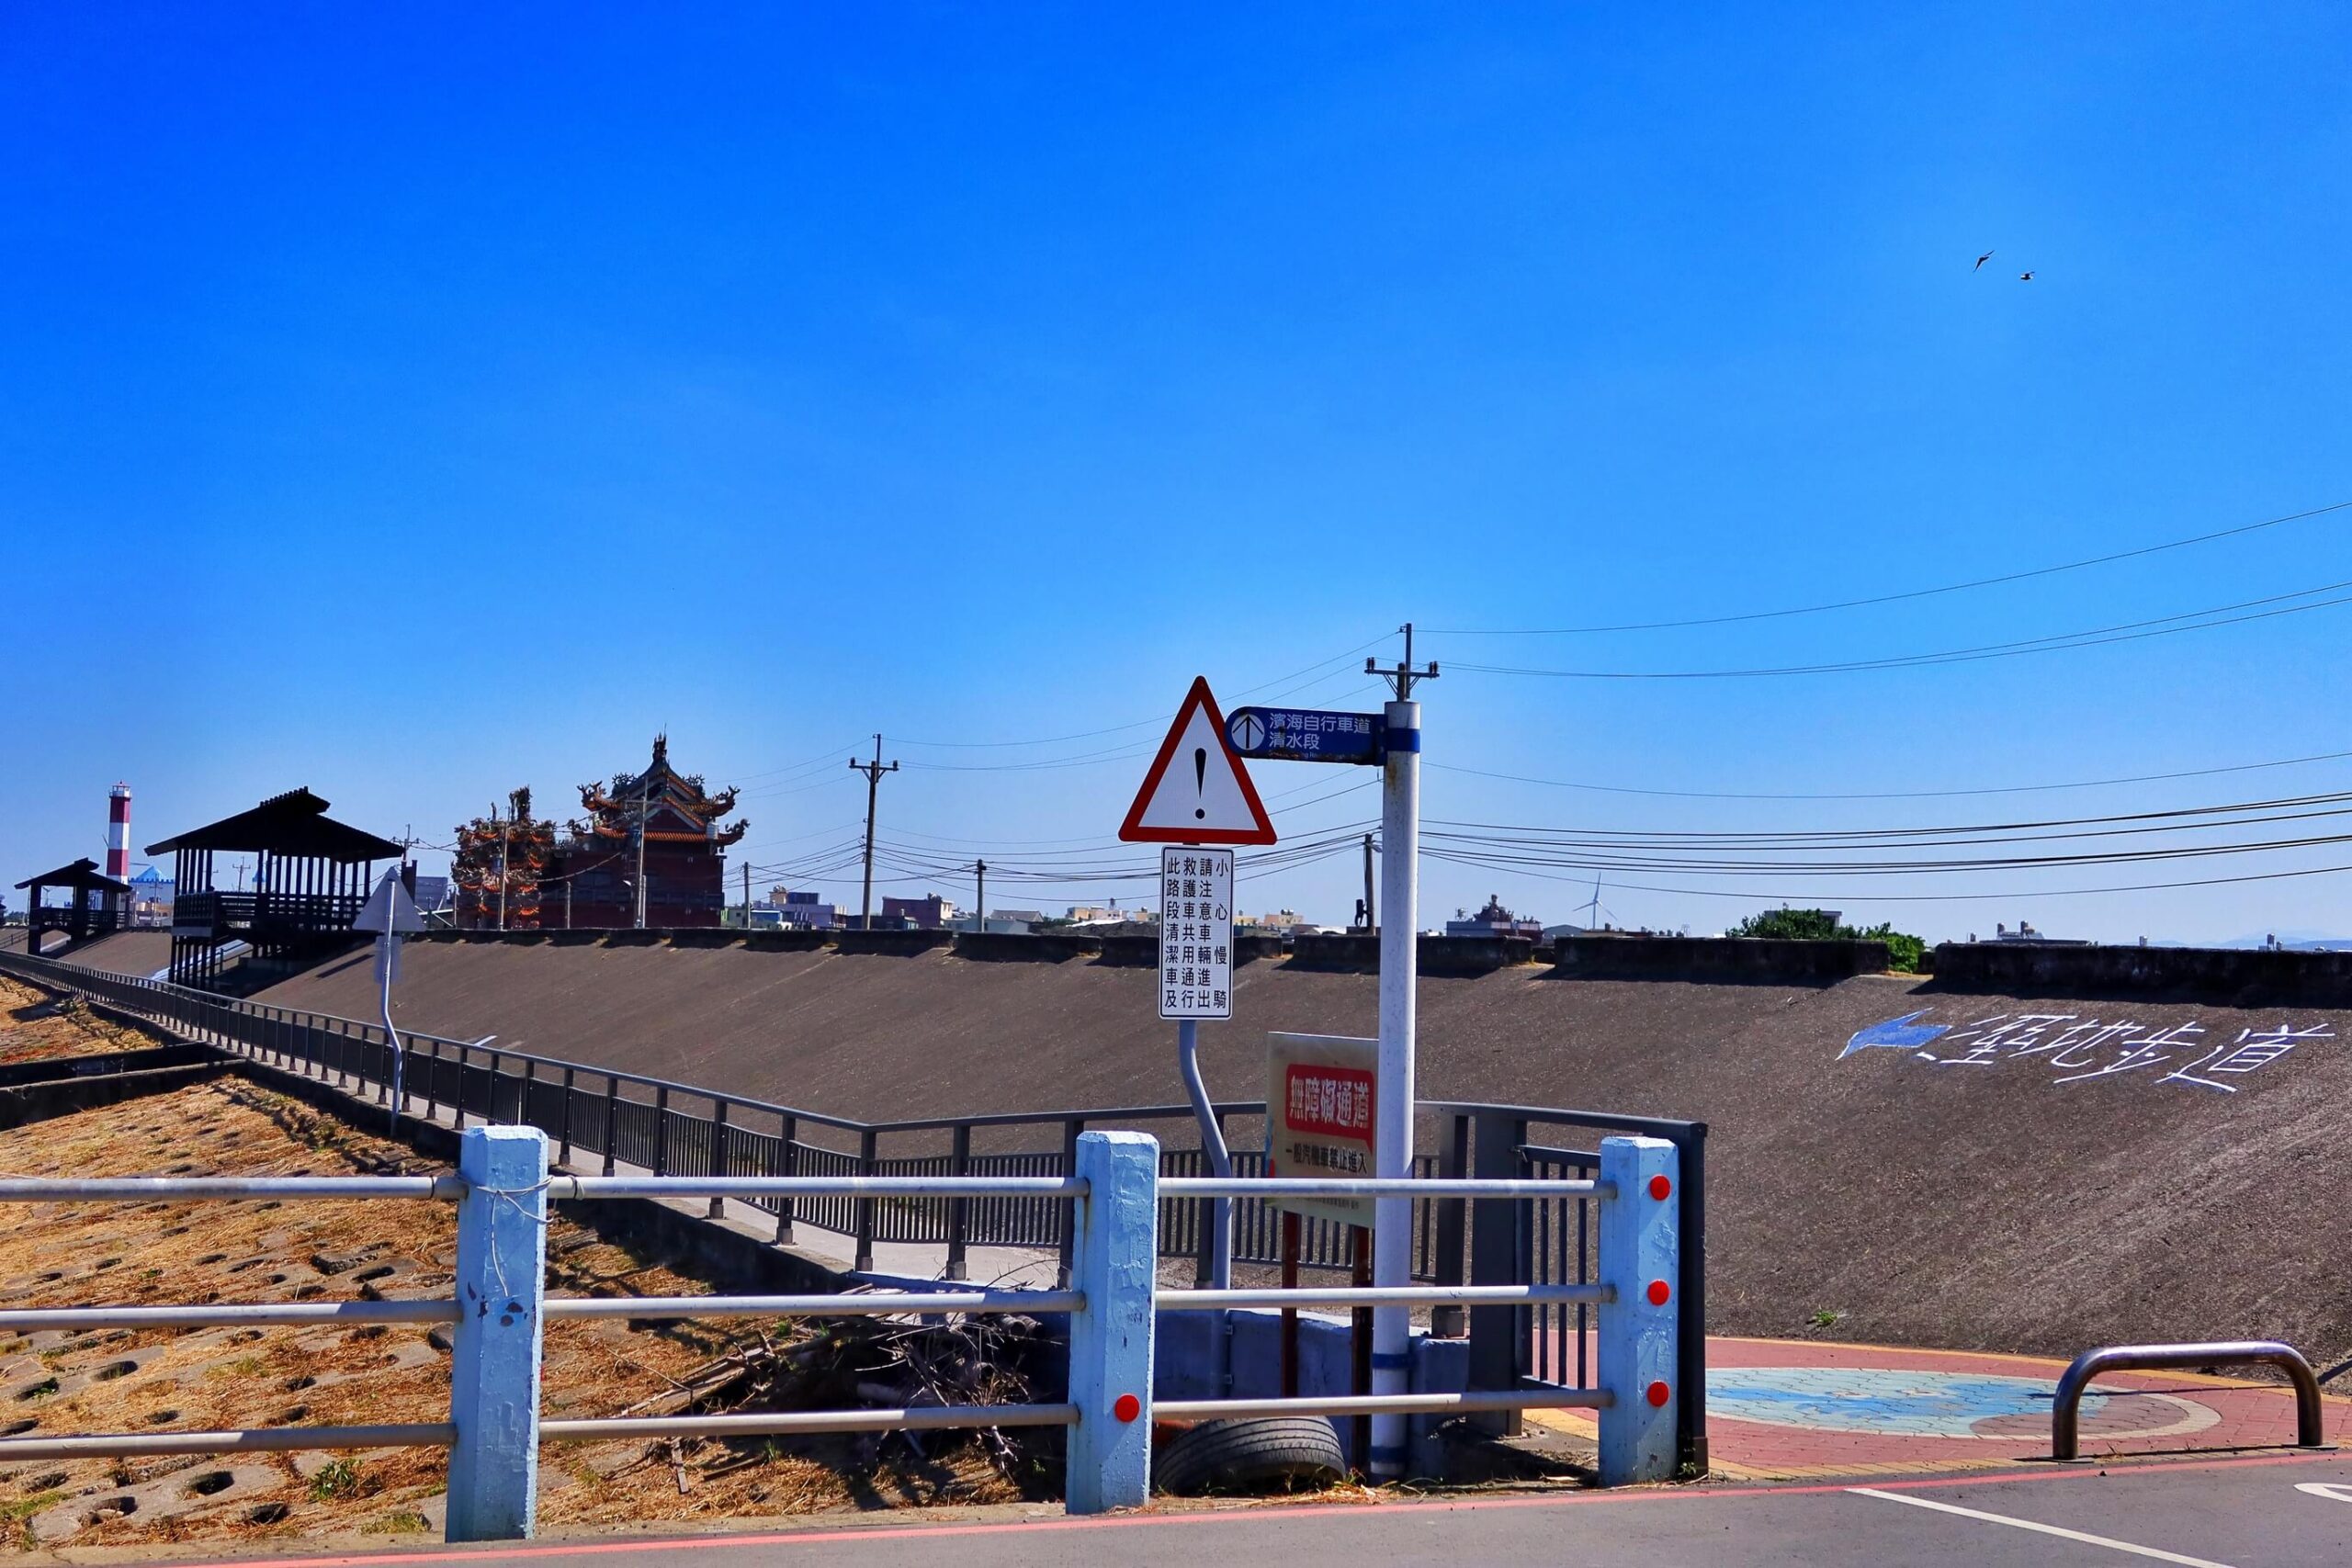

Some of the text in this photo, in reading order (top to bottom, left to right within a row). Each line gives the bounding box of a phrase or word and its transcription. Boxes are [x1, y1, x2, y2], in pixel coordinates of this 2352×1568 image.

[1270, 713, 1371, 734] 濱海自行車道
[1270, 732, 1319, 750] 清水段
[1164, 857, 1181, 1008] 此路段清潔車及
[1182, 858, 1196, 1009] 救護車共用通行
[1197, 858, 1213, 1009] 請注意車輛進出
[1214, 859, 1228, 1009] 小心慢騎
[1289, 1075, 1369, 1129] 無障礙通道
